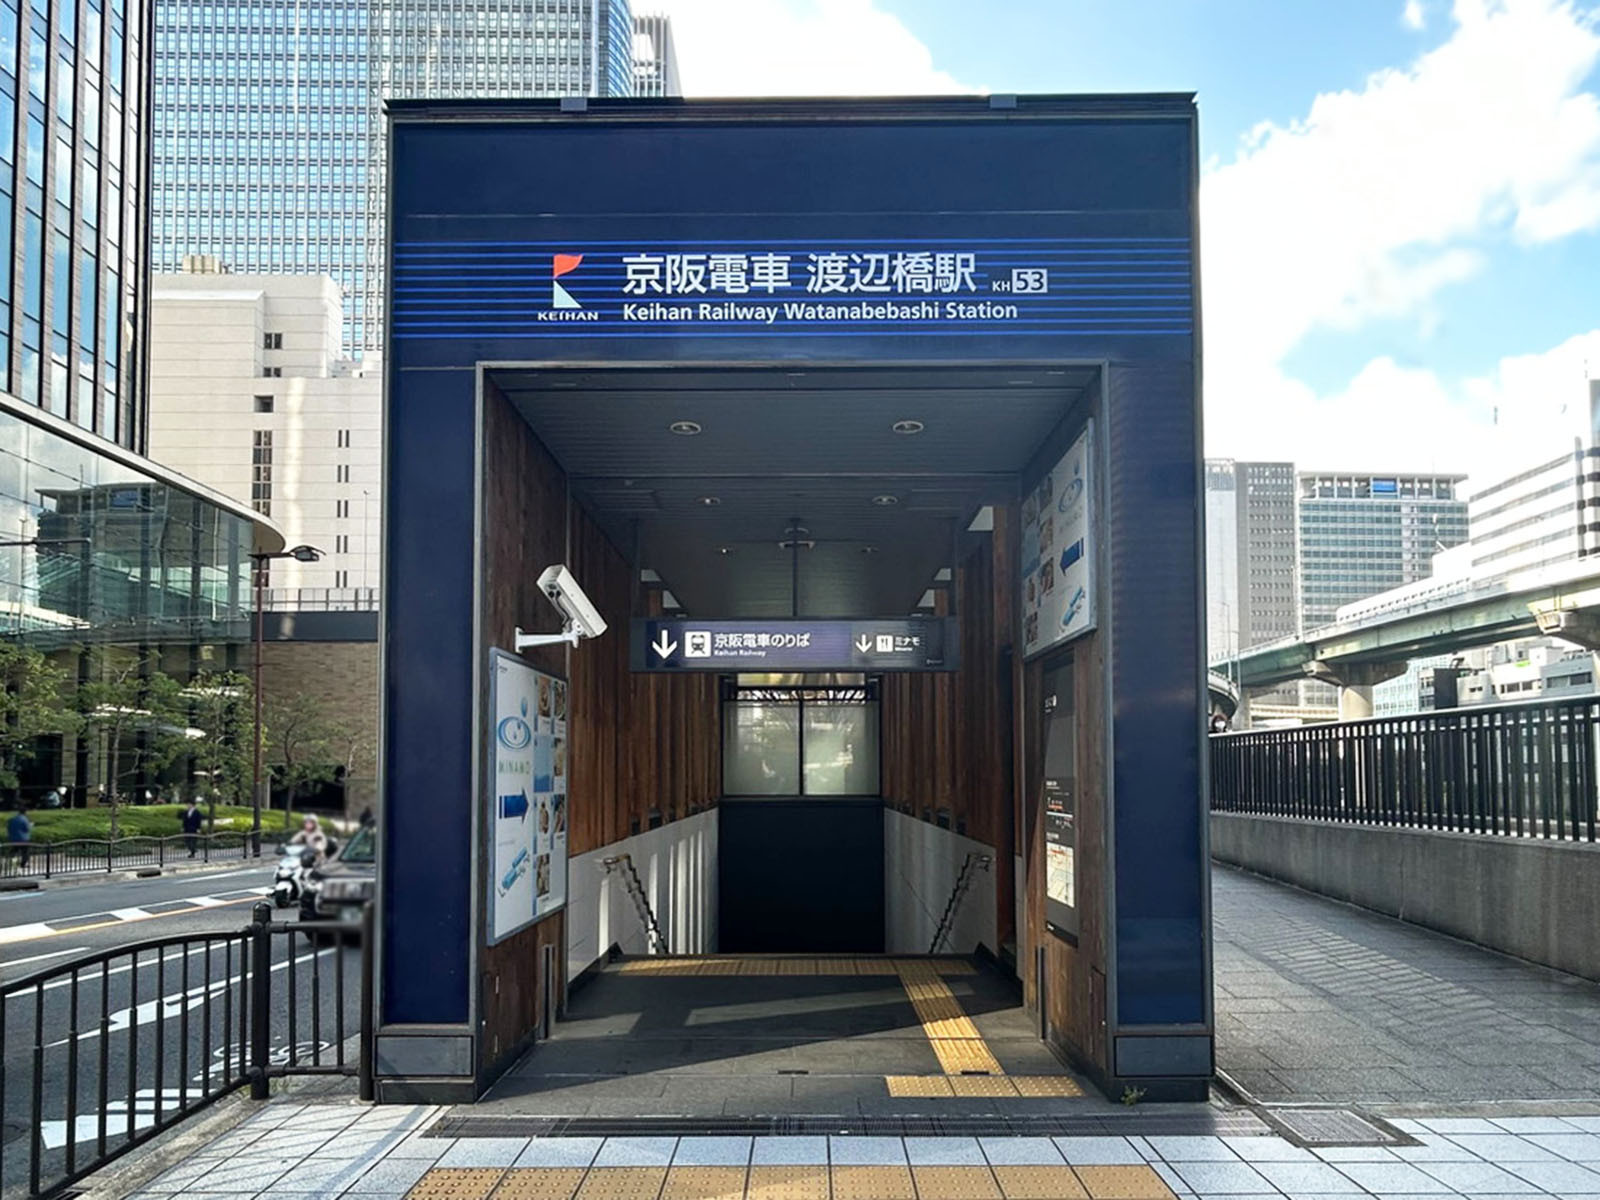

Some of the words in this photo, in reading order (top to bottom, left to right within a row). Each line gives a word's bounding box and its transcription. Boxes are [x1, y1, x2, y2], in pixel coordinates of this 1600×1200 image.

[622, 252, 792, 294] 京阪電車
[806, 252, 977, 294] 渡辺橋駅
[992, 280, 1010, 292] KH
[1016, 271, 1044, 291] 53
[537, 310, 599, 321] KEIHAN
[623, 302, 692, 321] Keihan
[699, 302, 778, 324] Railway
[784, 301, 939, 321] Watanabebashi
[945, 301, 1018, 319] Station
[713, 632, 811, 648] 京阪電車のりば
